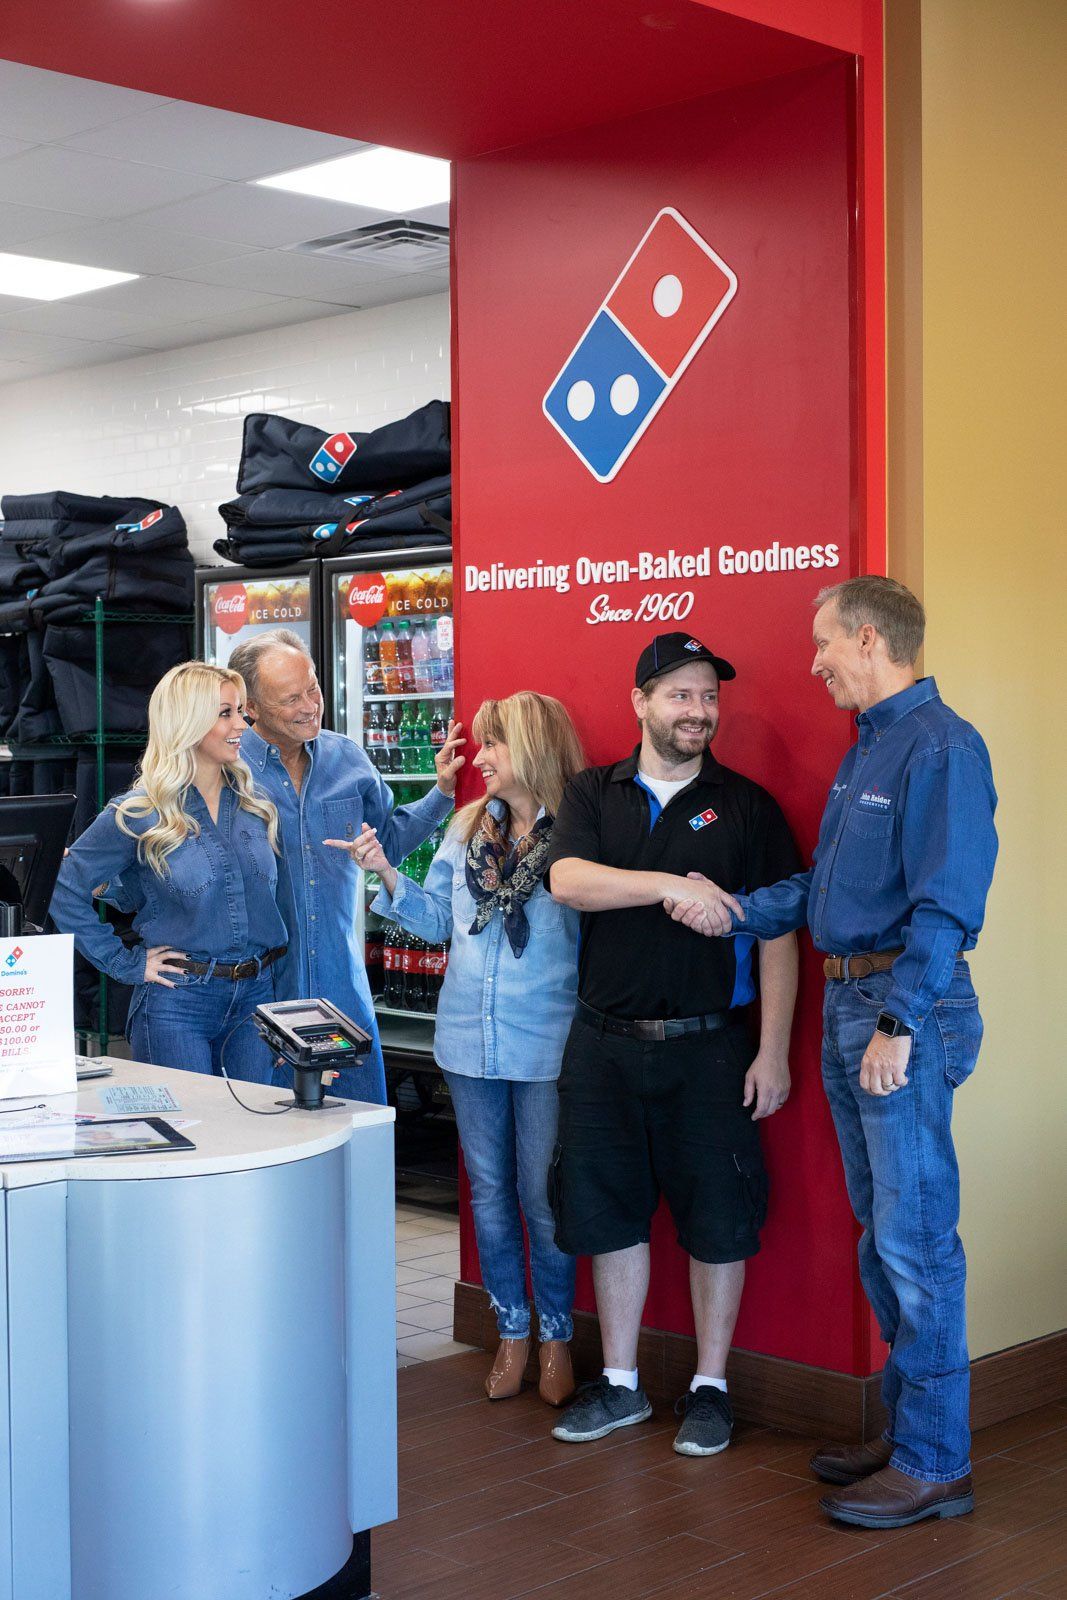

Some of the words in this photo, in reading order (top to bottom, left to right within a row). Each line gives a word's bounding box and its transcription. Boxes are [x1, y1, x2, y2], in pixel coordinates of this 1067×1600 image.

[465, 559, 570, 593] Delivering
[576, 547, 710, 585] Oven-Baked
[718, 541, 840, 575] Goodness
[391, 599, 411, 611] ICE
[416, 597, 449, 609] COLD
[586, 594, 633, 625] Since
[634, 591, 695, 622] 1960
[251, 609, 268, 619] ICE
[273, 607, 302, 618] COLD
[0, 987, 34, 998] SORRY!
[6, 1000, 46, 1012] CANNOT
[2, 1047, 30, 1057] BILLS
